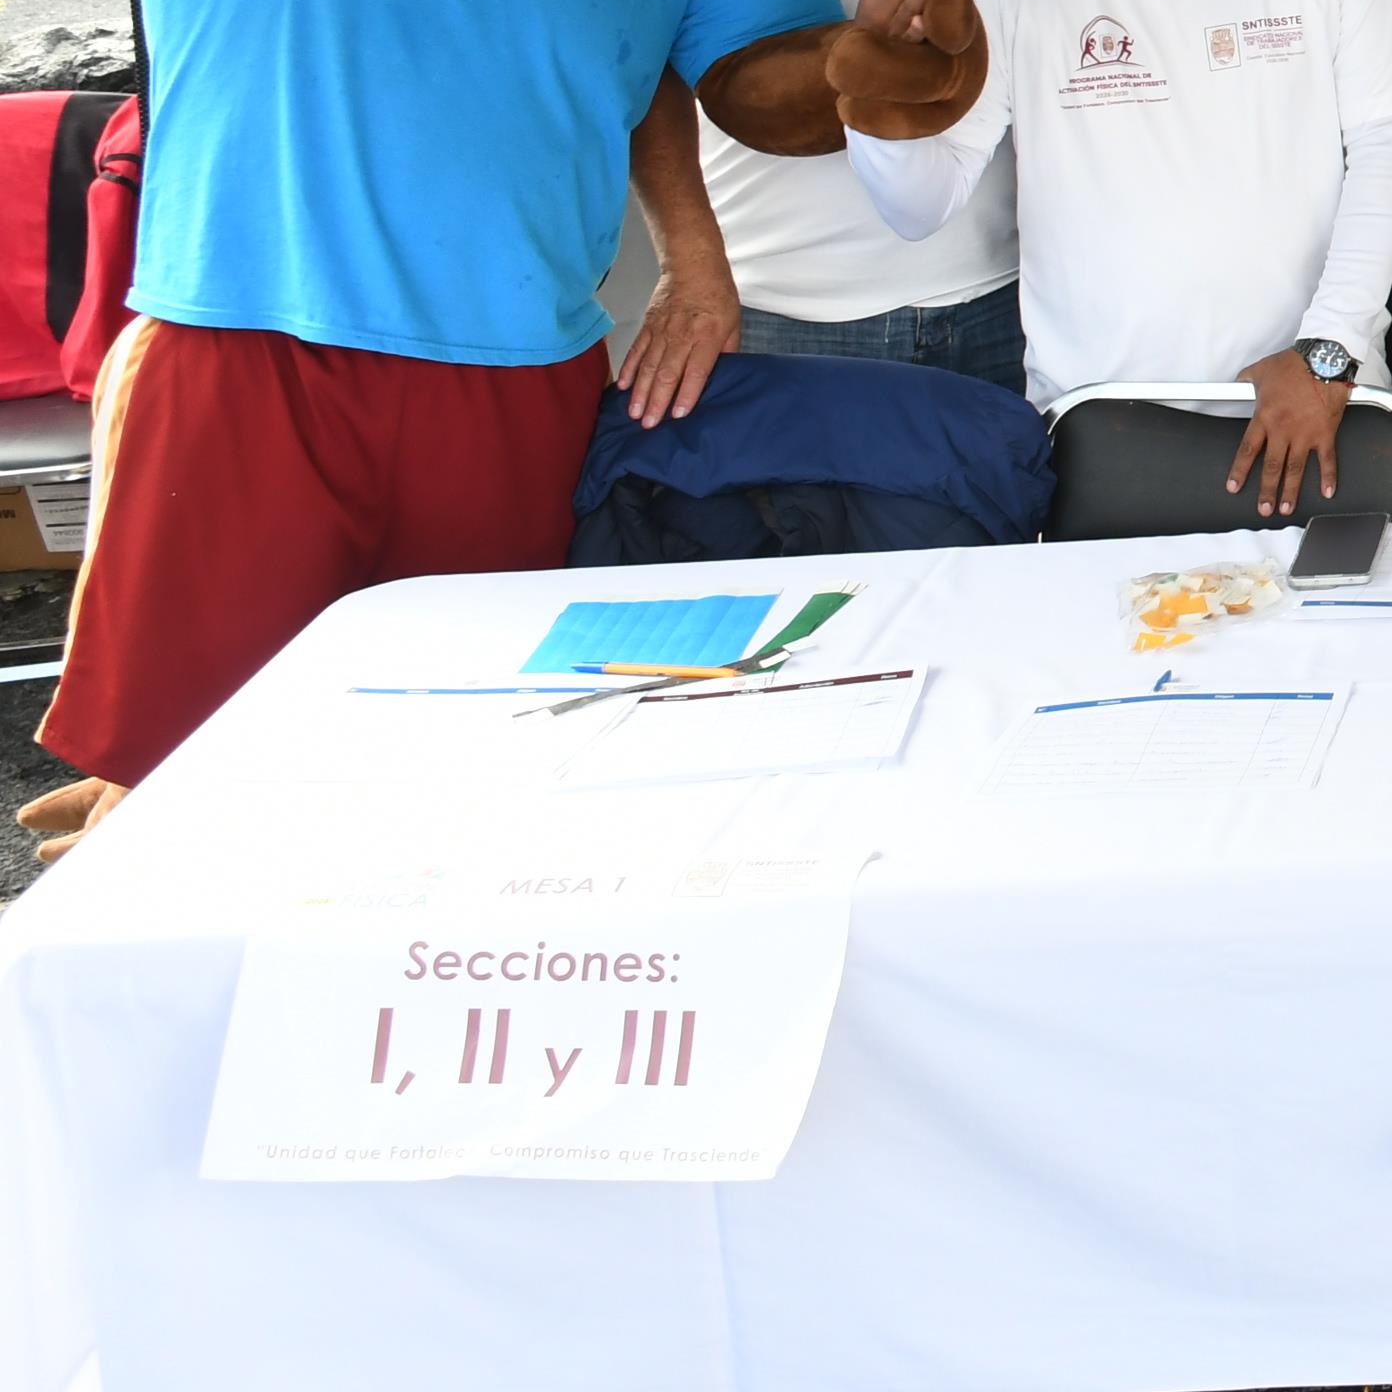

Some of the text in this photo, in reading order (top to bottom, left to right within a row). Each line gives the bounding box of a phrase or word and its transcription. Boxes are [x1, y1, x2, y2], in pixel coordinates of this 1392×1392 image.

[1242, 15, 1302, 30] SNTISSSTE
[499, 876, 628, 898] MESA 1
[404, 941, 682, 983] Secciones:
[369, 1007, 696, 1098] I, II y III
[344, 1147, 380, 1163] que
[621, 1147, 655, 1163] que
